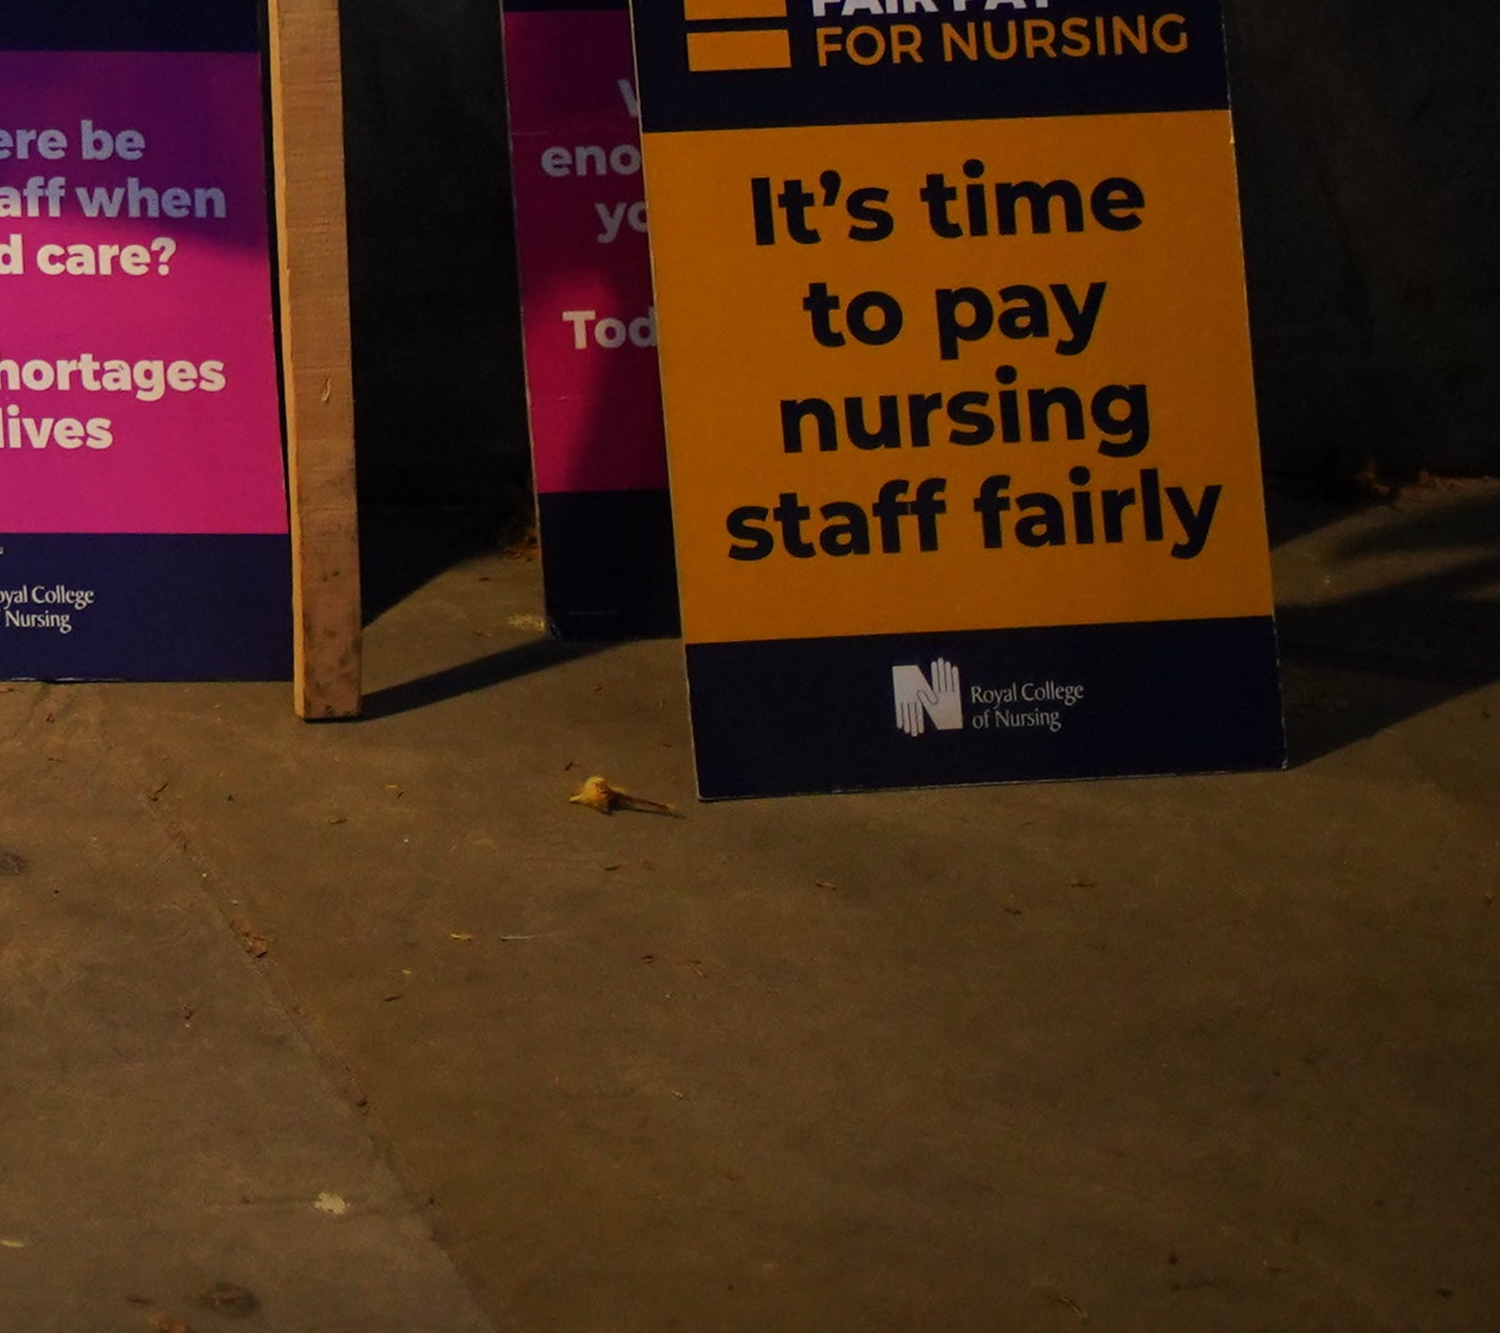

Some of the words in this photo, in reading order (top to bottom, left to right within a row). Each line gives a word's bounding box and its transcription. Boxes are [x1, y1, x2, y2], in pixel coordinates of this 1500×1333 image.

[815, 22, 923, 66] FOR
[942, 14, 1189, 62] NURSING
[81, 119, 145, 160] be
[76, 179, 226, 219] when
[750, 169, 894, 245] It's
[919, 159, 1146, 239] time
[36, 238, 177, 276] care?
[804, 282, 904, 348] to
[935, 281, 1106, 361] pay
[780, 365, 1151, 457] nursing
[726, 478, 947, 561] staff
[974, 468, 1222, 560] fairly
[32, 585, 94, 611] College
[5, 609, 71, 633] Nursing
[970, 684, 1017, 706] Royal
[1021, 682, 1084, 703] College
[972, 709, 992, 728] of
[995, 708, 1062, 731] Nursing
